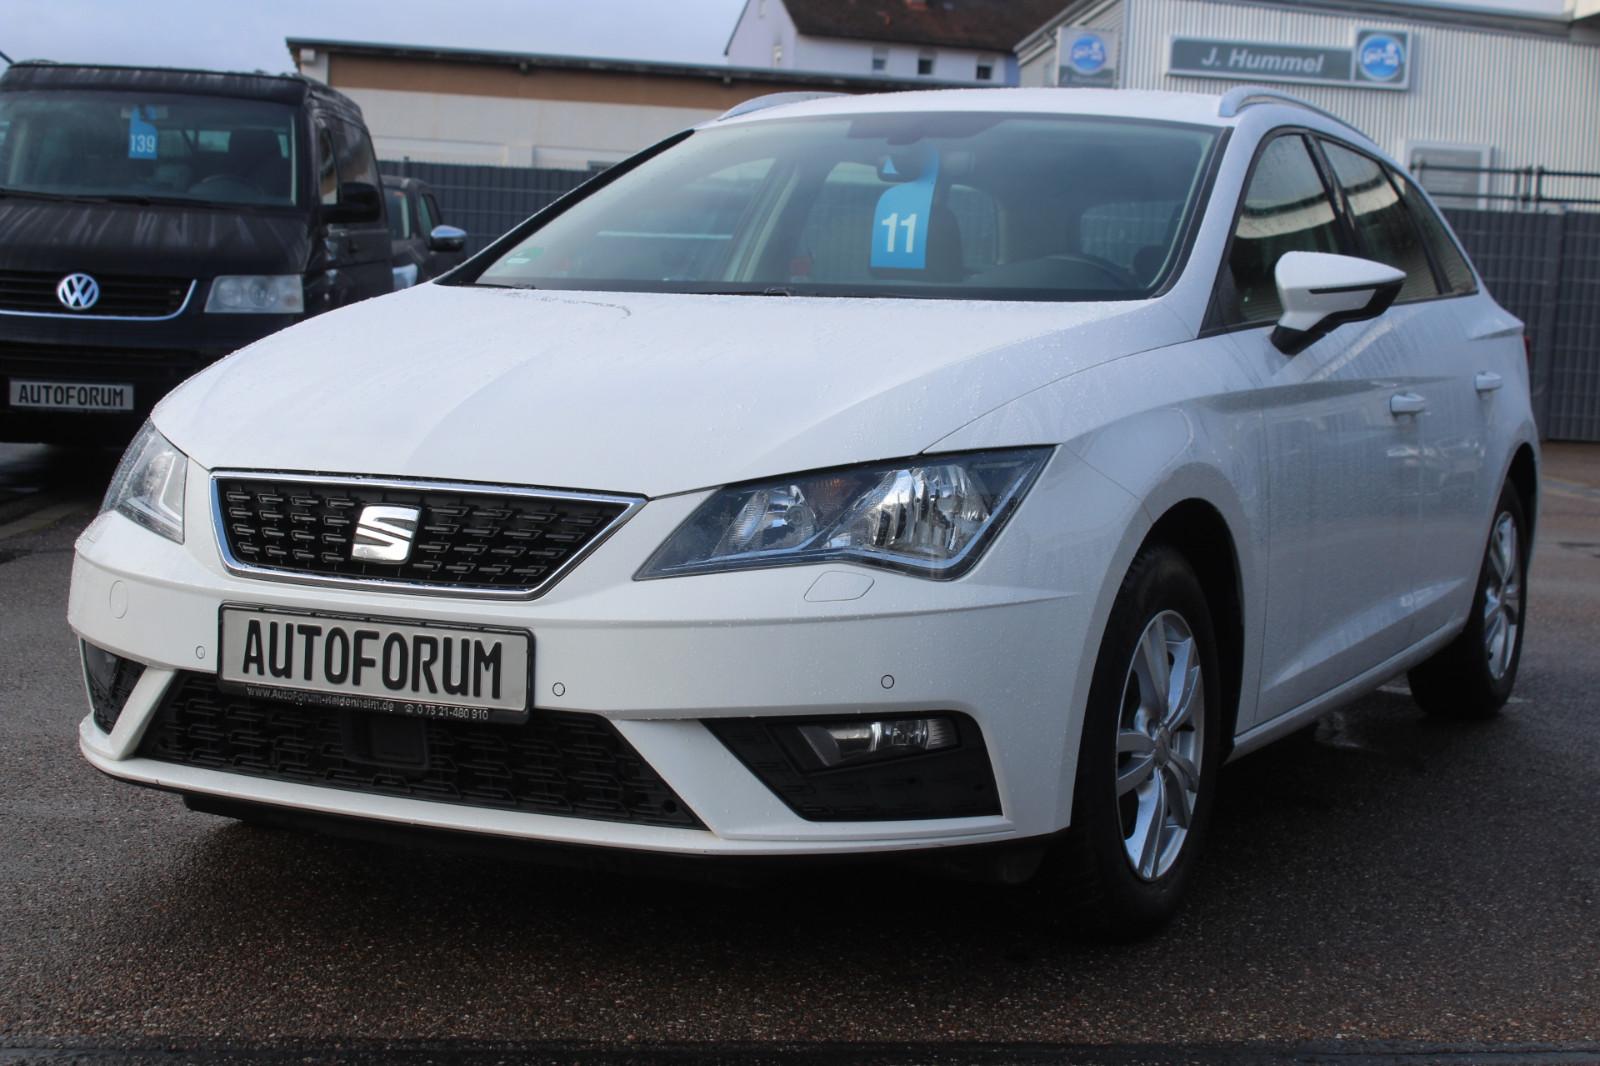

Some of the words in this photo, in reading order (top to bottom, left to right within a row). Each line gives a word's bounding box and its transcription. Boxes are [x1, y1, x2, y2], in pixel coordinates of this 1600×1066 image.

[1201, 46, 1221, 67] J.
[1228, 48, 1325, 73] Hummel
[130, 134, 156, 153] 139
[882, 212, 917, 253] 11
[18, 384, 125, 407] AUTOFORUM
[242, 619, 502, 699] AUTOFORUM
